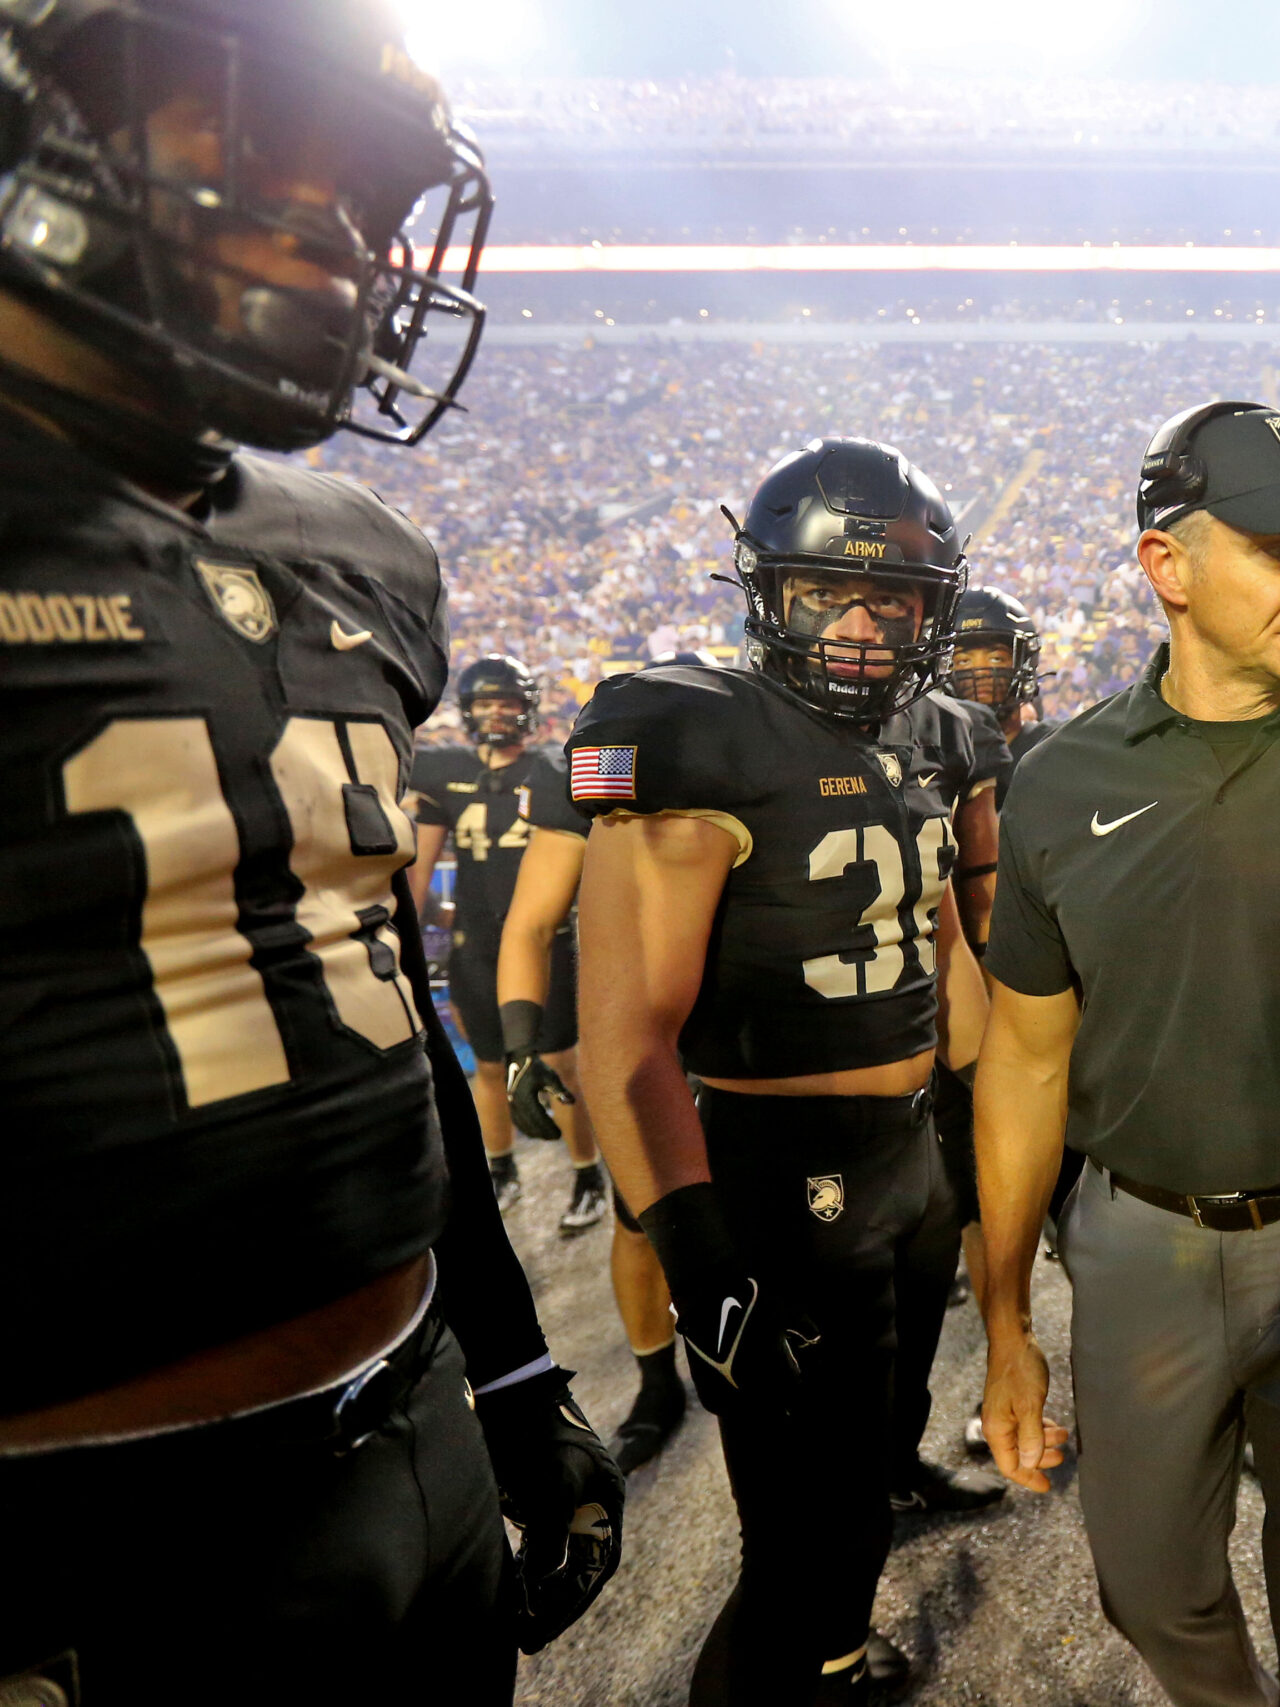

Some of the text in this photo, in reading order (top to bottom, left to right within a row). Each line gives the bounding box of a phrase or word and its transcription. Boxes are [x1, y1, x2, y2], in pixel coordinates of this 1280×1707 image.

[844, 540, 886, 558] ARMY
[828, 682, 870, 696] Riddll
[819, 776, 867, 796] GERENA
[63, 717, 425, 1110] 18
